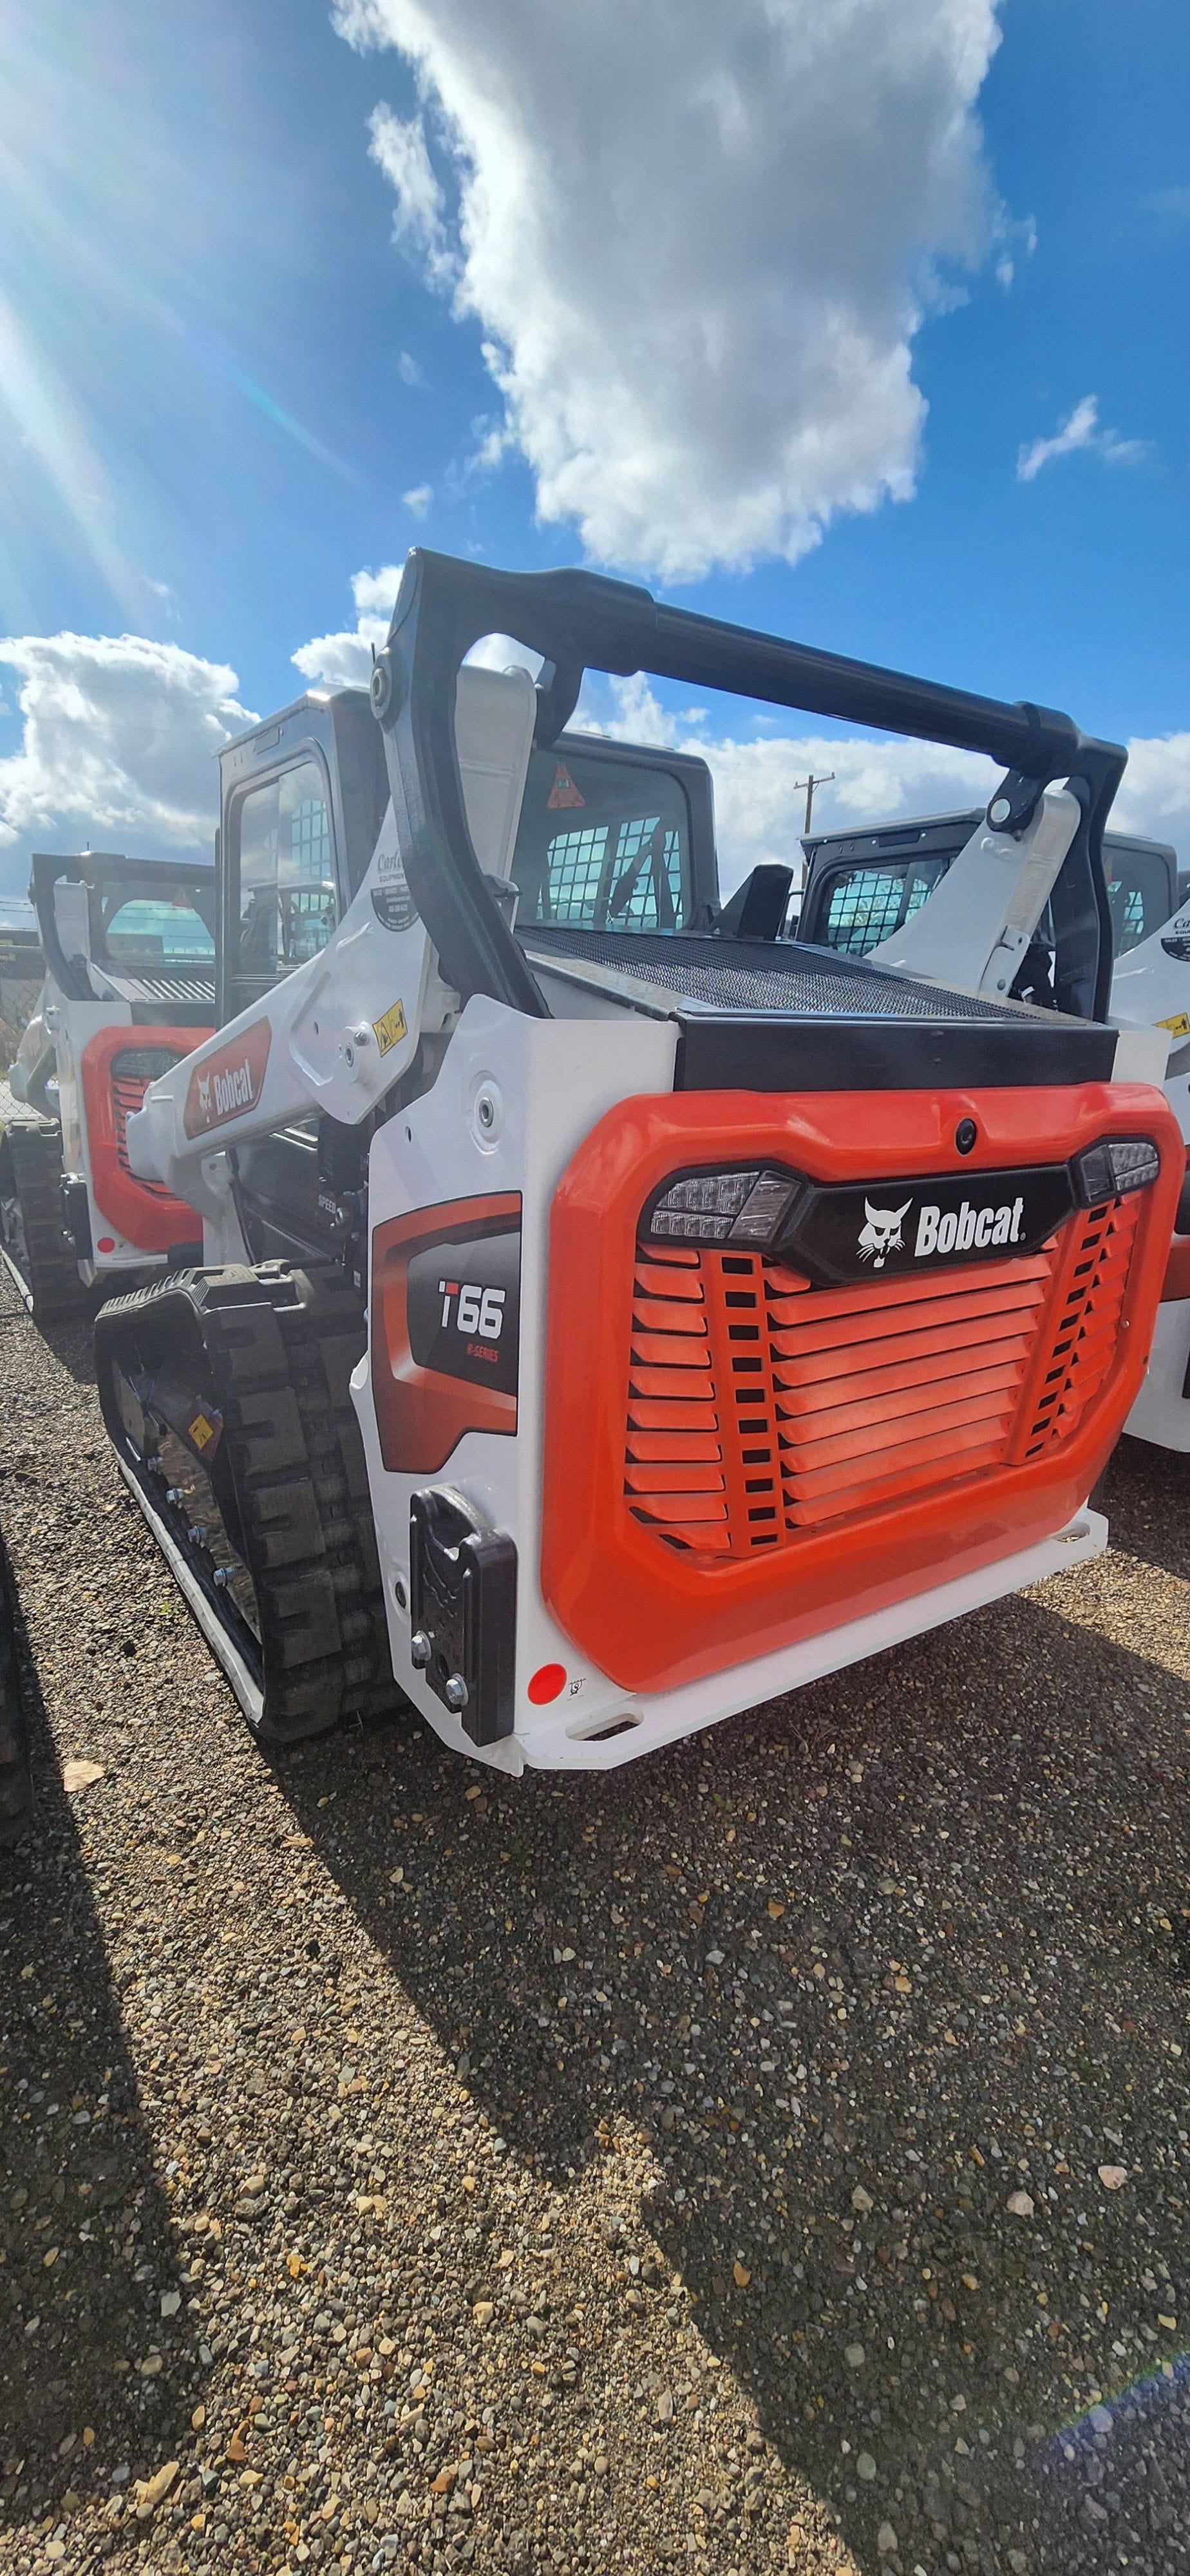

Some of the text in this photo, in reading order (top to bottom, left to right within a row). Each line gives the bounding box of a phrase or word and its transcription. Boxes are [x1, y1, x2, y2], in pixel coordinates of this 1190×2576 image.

[213, 1058, 254, 1116] Bobcat
[318, 1194, 336, 1215] SPEED
[439, 1280, 506, 1340] T66
